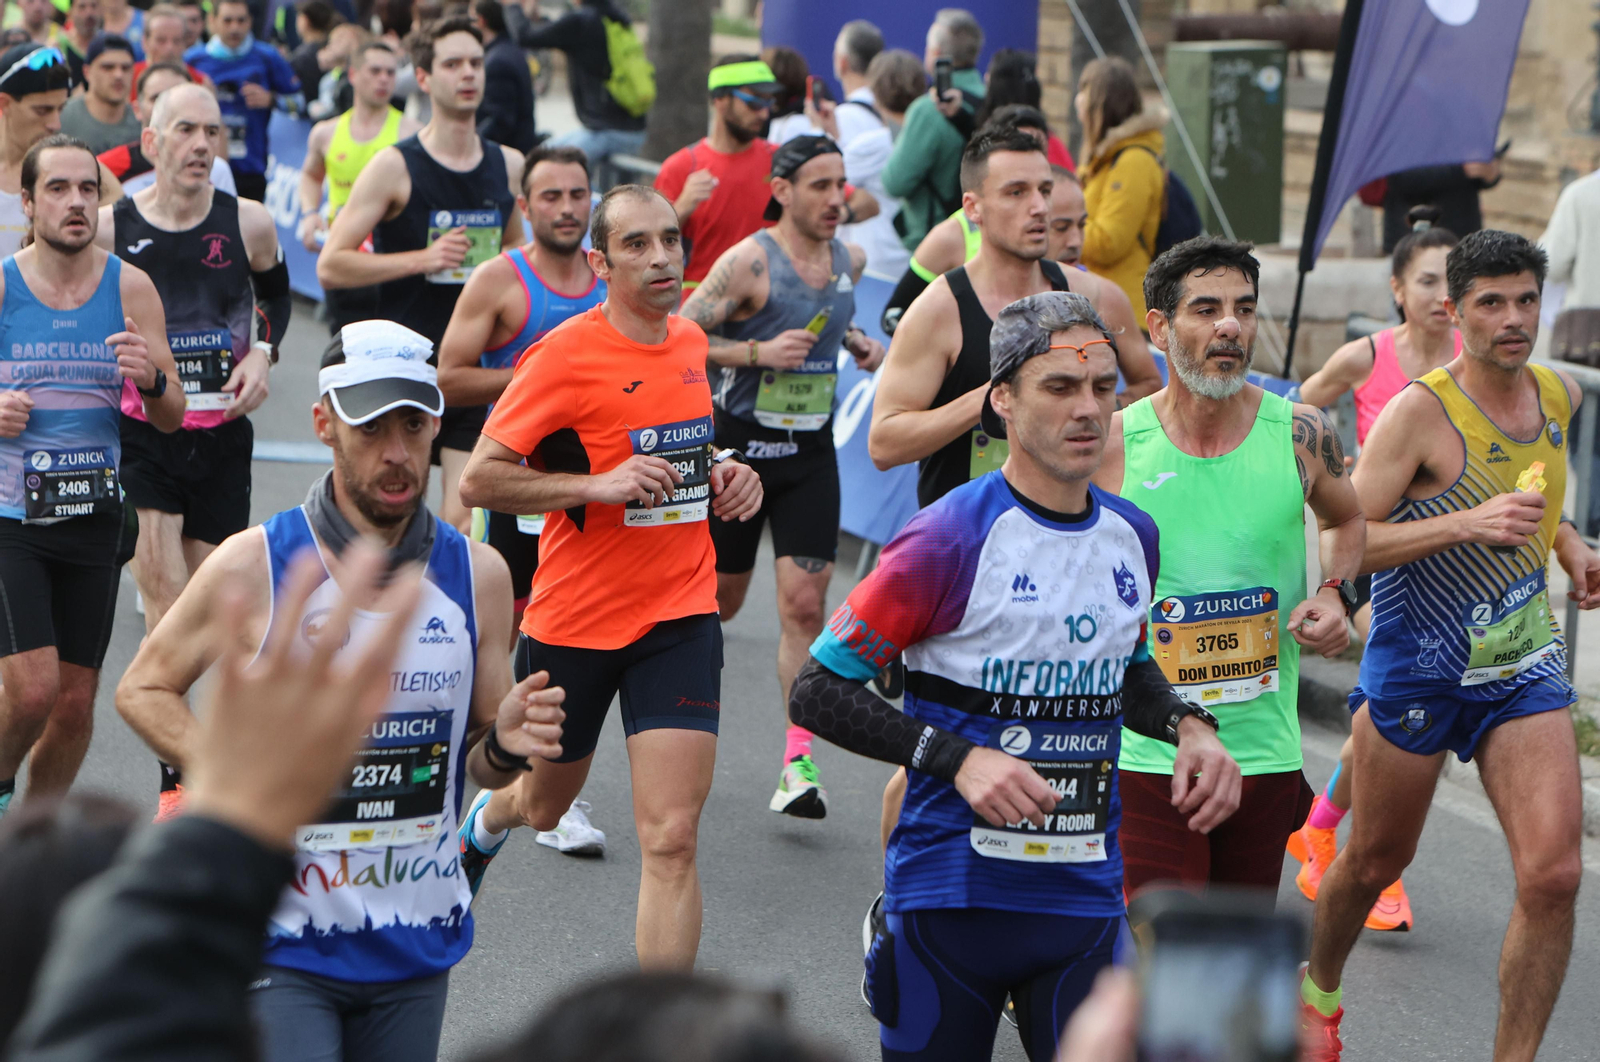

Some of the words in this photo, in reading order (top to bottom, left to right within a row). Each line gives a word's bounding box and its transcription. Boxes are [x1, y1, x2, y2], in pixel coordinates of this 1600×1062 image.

[455, 213, 495, 226] ZURICH
[11, 342, 116, 359] BARCELONA
[171, 334, 222, 349] ZURICH
[11, 364, 57, 380] CASUAL
[58, 365, 115, 381] RUNNERS
[662, 423, 708, 444] ZURICH
[58, 452, 105, 466] ZURICH
[58, 480, 90, 497] 2406
[55, 502, 94, 516] STUART
[1012, 595, 1039, 603] mobel
[1194, 594, 1263, 616] ZURICH
[1498, 578, 1539, 615] ZURICH
[1064, 614, 1097, 643] 10
[1196, 633, 1239, 653] 3765
[1178, 666, 1207, 681] DON
[1211, 660, 1261, 678] DURITO
[388, 670, 461, 692] TLETISMO
[990, 697, 1003, 715] X
[360, 718, 437, 739] URICH
[1040, 734, 1108, 751] ZURICH
[352, 764, 402, 787] 2374
[356, 800, 395, 819] IVAN
[1043, 815, 1055, 832] Y
[1056, 813, 1096, 832] RODRI
